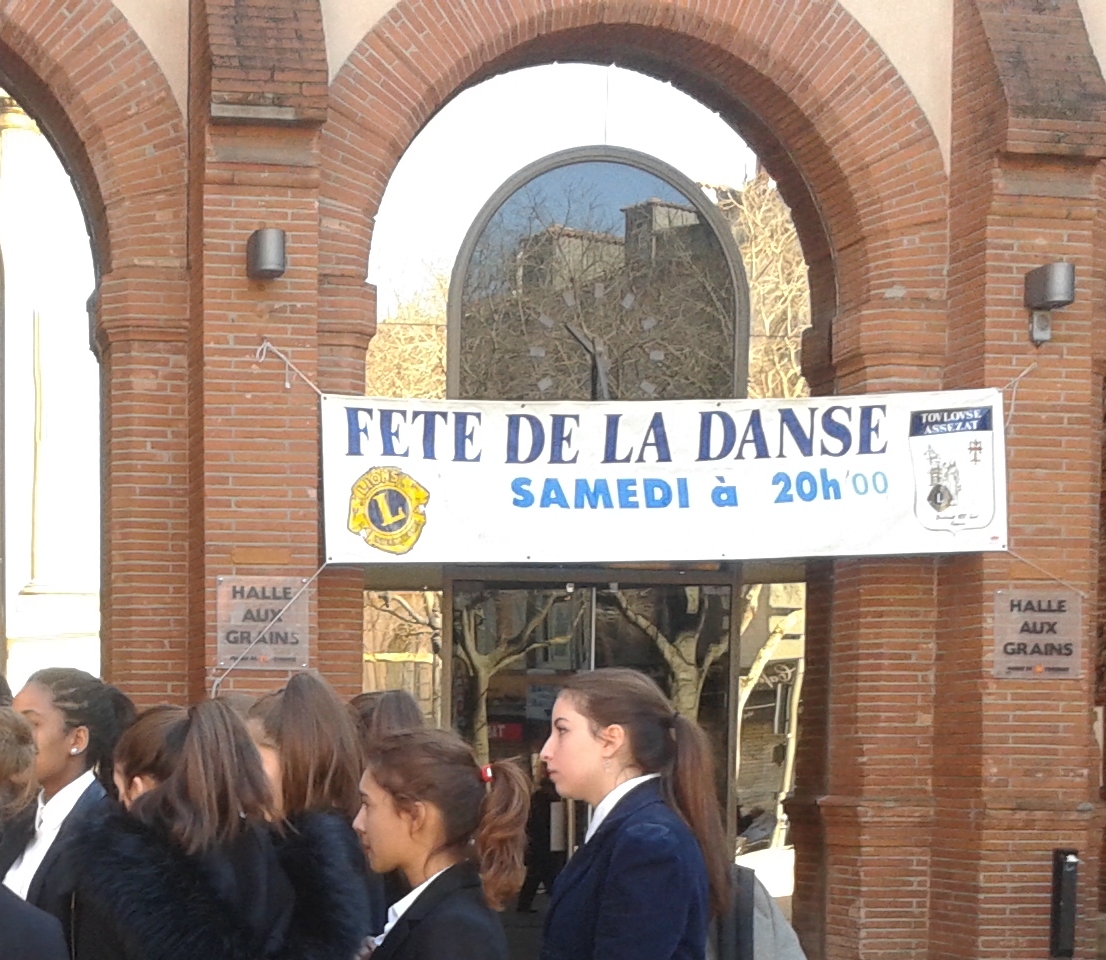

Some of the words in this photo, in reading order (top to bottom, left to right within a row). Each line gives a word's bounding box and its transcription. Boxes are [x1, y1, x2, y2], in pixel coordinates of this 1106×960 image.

[344, 406, 482, 462] FETE
[505, 413, 580, 464] DE
[600, 411, 672, 464] LA
[694, 404, 888, 462] DANSE
[924, 420, 979, 434] ASSEZAT
[510, 476, 690, 509] SAMEDI
[710, 475, 738, 507] à
[232, 585, 293, 600] HALLE
[1009, 599, 1067, 612] HALLE
[241, 608, 283, 622] AUX
[1019, 621, 1057, 634] AUX
[226, 630, 300, 645] GRAINS
[1003, 642, 1073, 656] GRAINS
